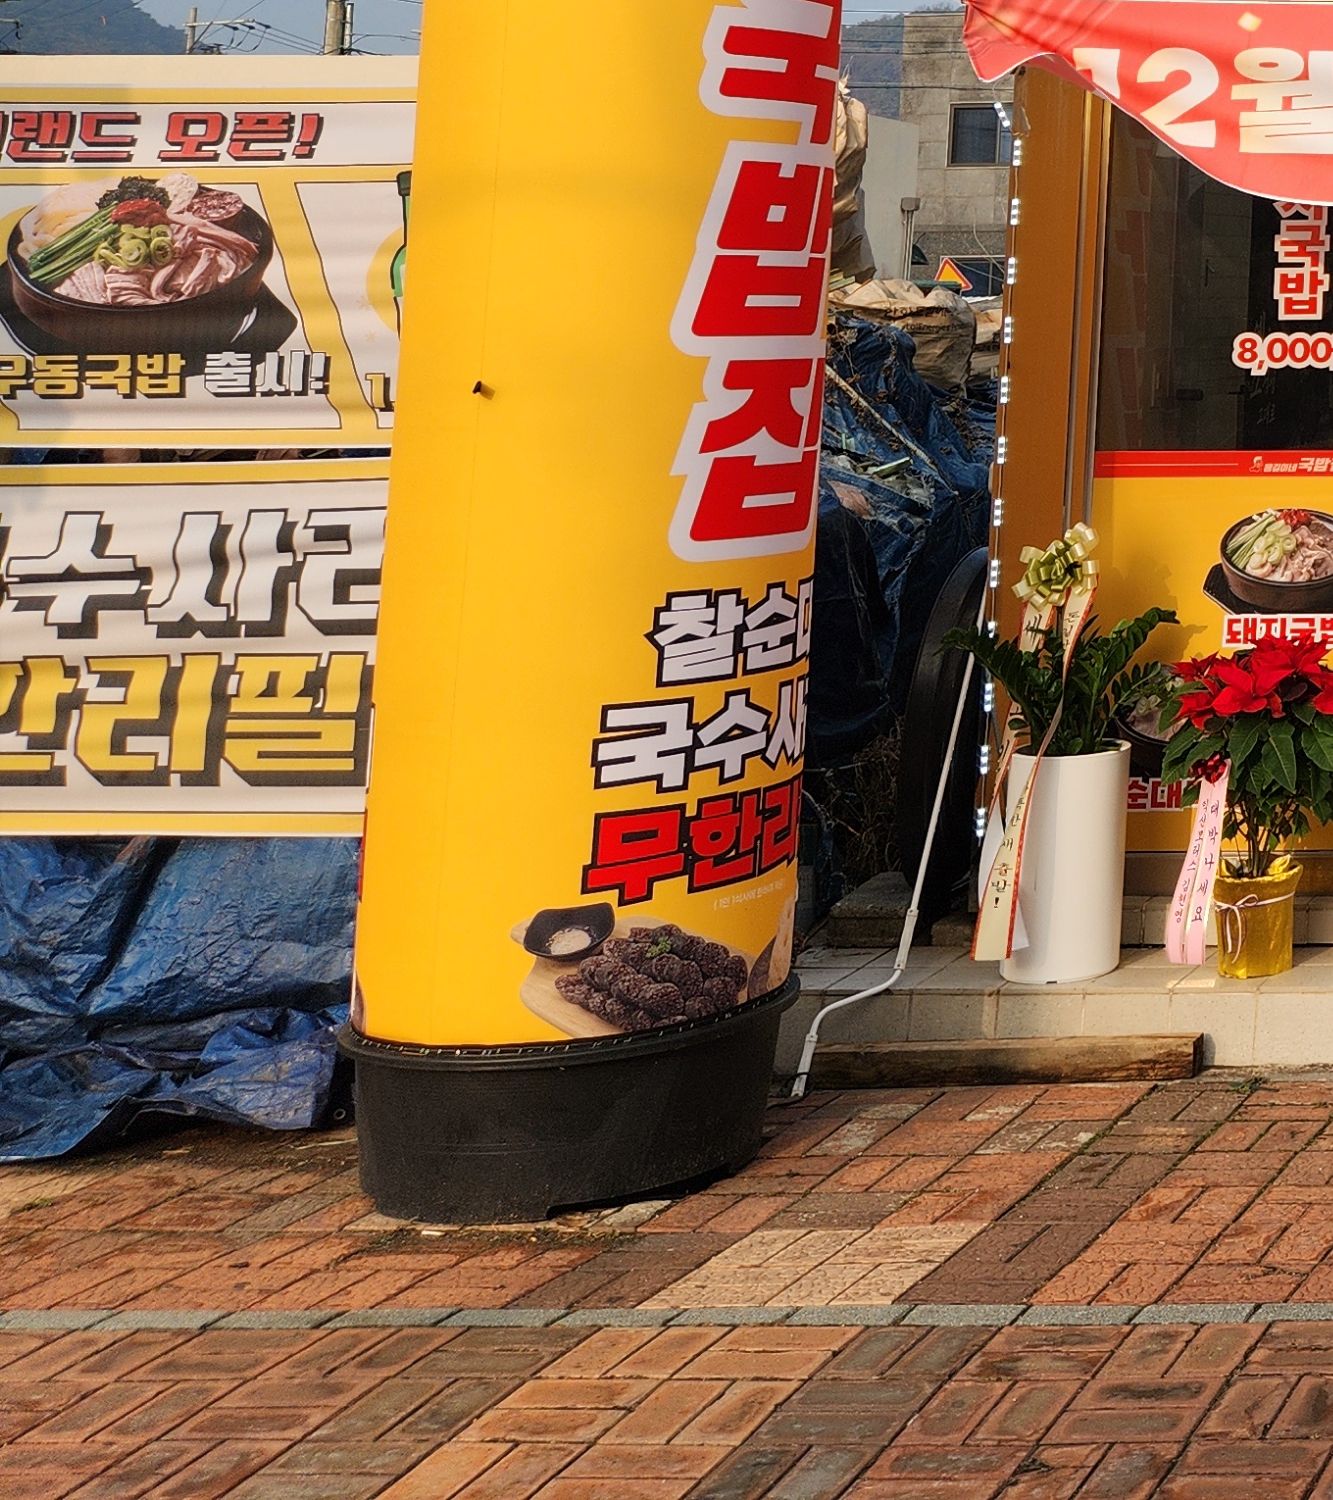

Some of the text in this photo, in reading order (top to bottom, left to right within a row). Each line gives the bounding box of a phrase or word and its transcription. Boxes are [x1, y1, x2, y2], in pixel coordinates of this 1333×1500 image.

[0, 109, 325, 166] 랜드 오픈!
[203, 350, 330, 400] 출시!
[0, 510, 388, 638] 수사
[652, 583, 815, 684] 찰순
[1127, 778, 1186, 810] 순대
